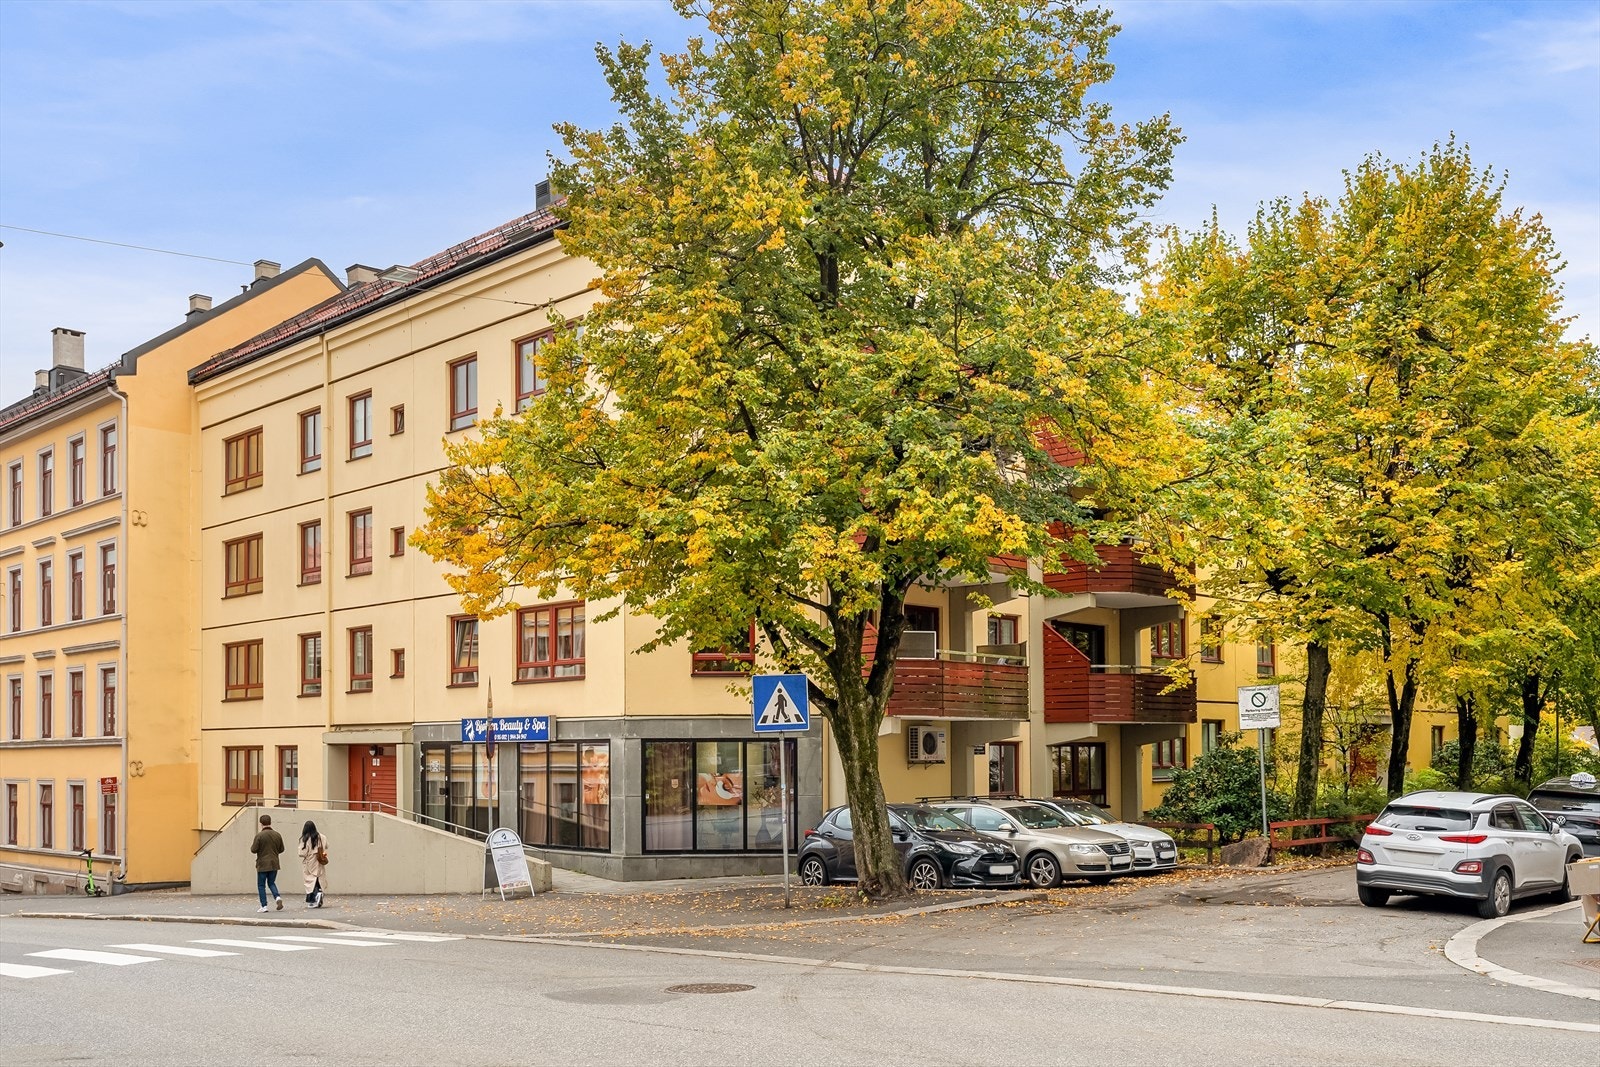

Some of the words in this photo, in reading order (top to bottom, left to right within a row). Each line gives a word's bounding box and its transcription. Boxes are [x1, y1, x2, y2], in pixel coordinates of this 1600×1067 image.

[500, 719, 523, 733] Beauty
[525, 718, 530, 729] &
[532, 718, 546, 733] Spa
